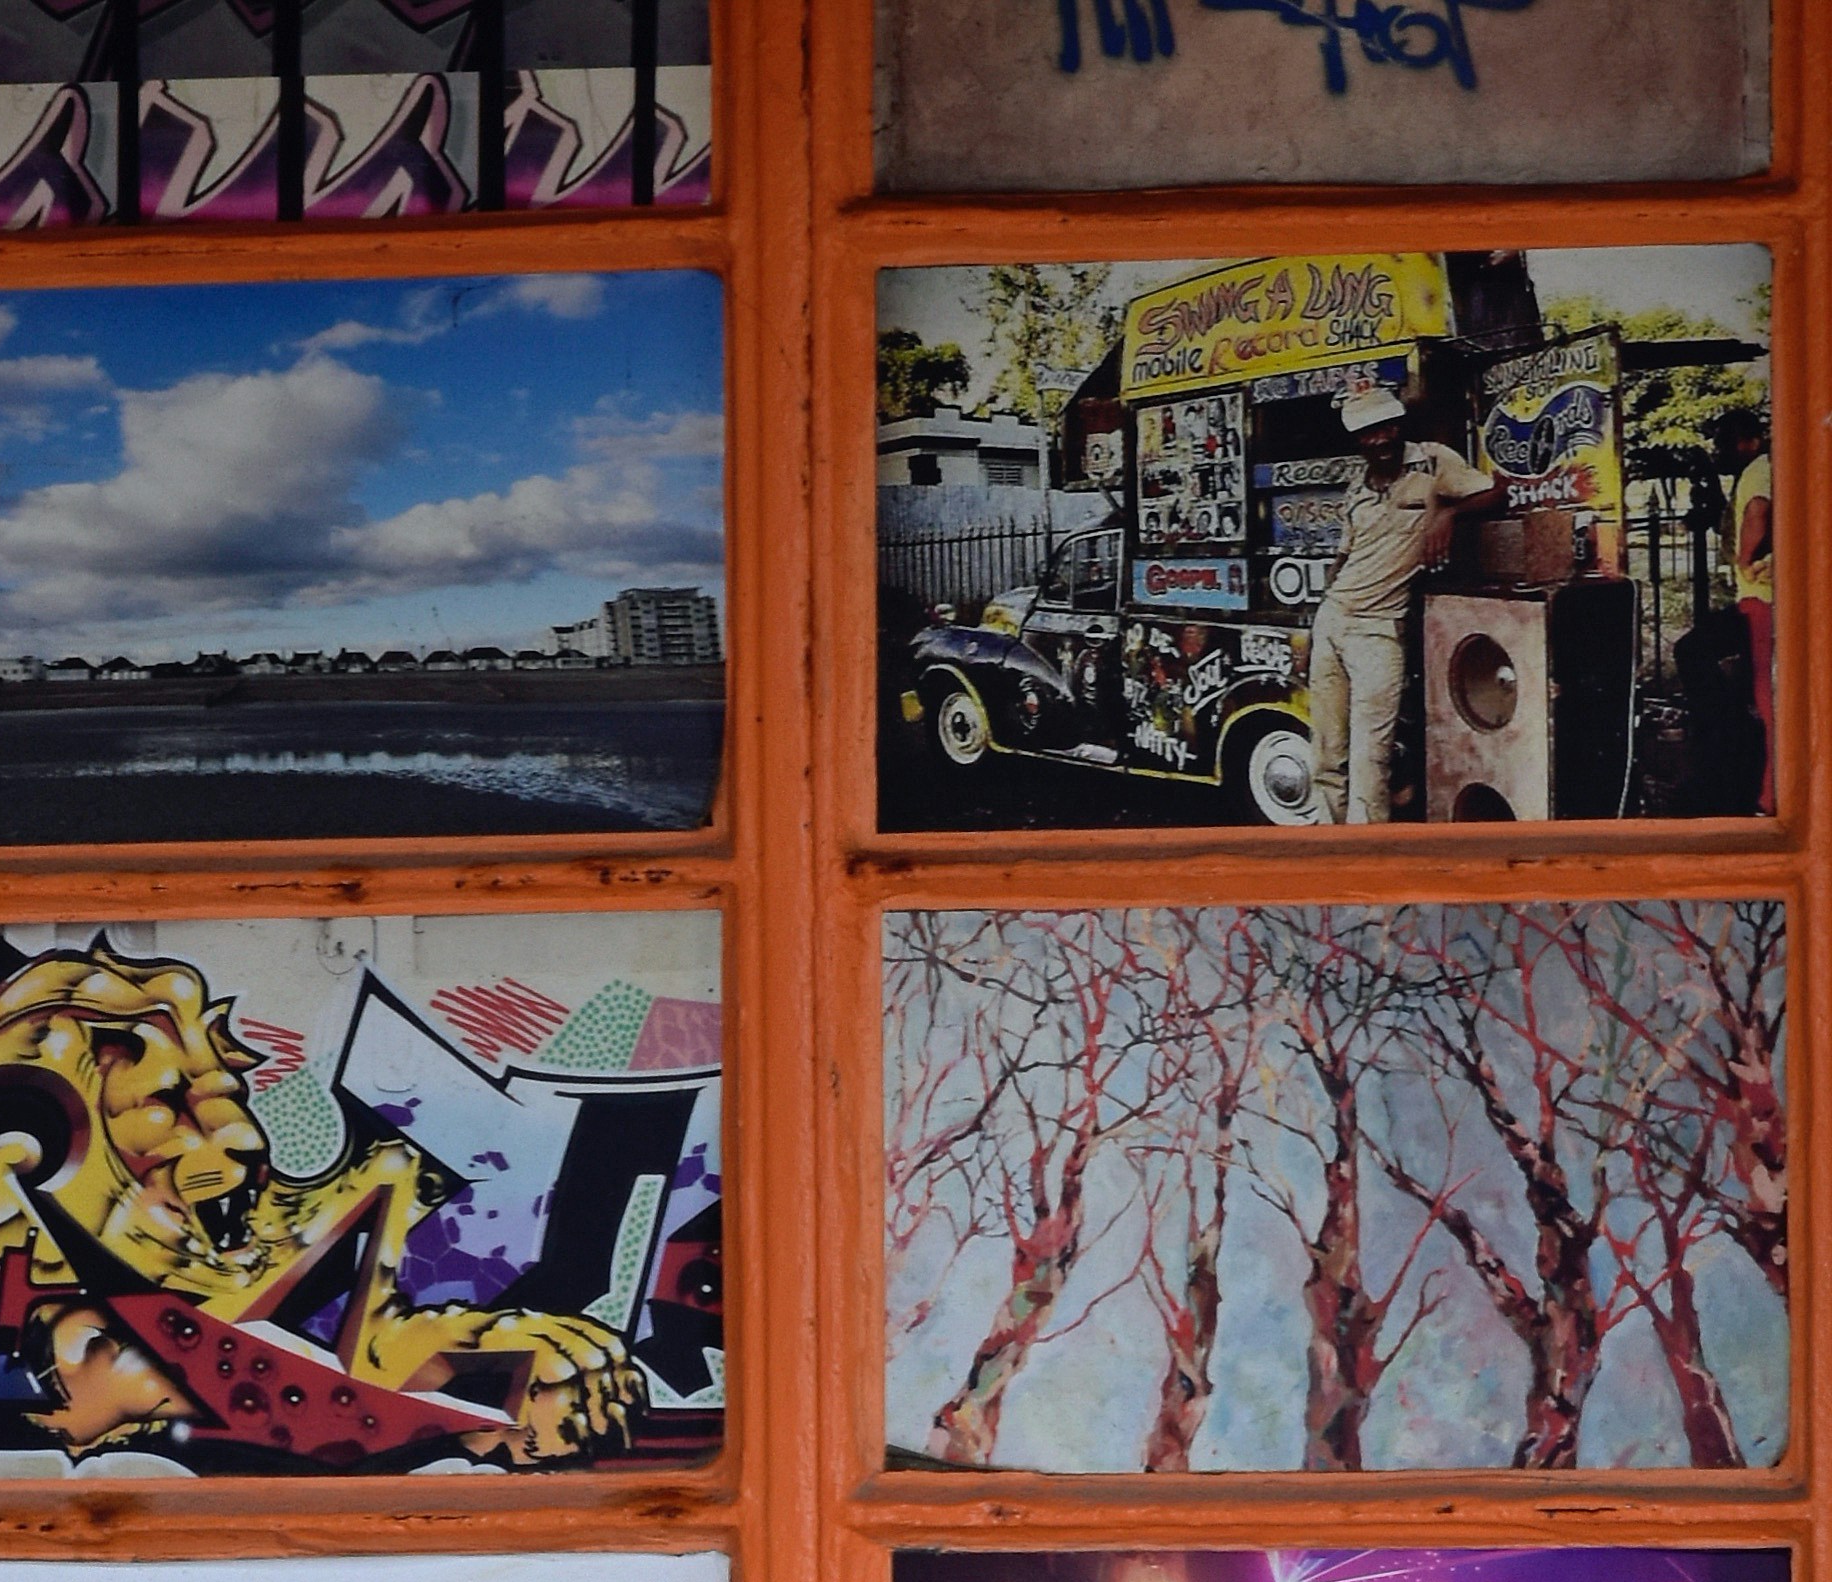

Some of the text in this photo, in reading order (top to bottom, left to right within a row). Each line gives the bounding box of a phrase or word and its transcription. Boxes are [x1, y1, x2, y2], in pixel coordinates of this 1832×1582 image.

[1265, 268, 1296, 321] A
[1132, 347, 1203, 384] mobile
[1507, 472, 1580, 508] SHACK
